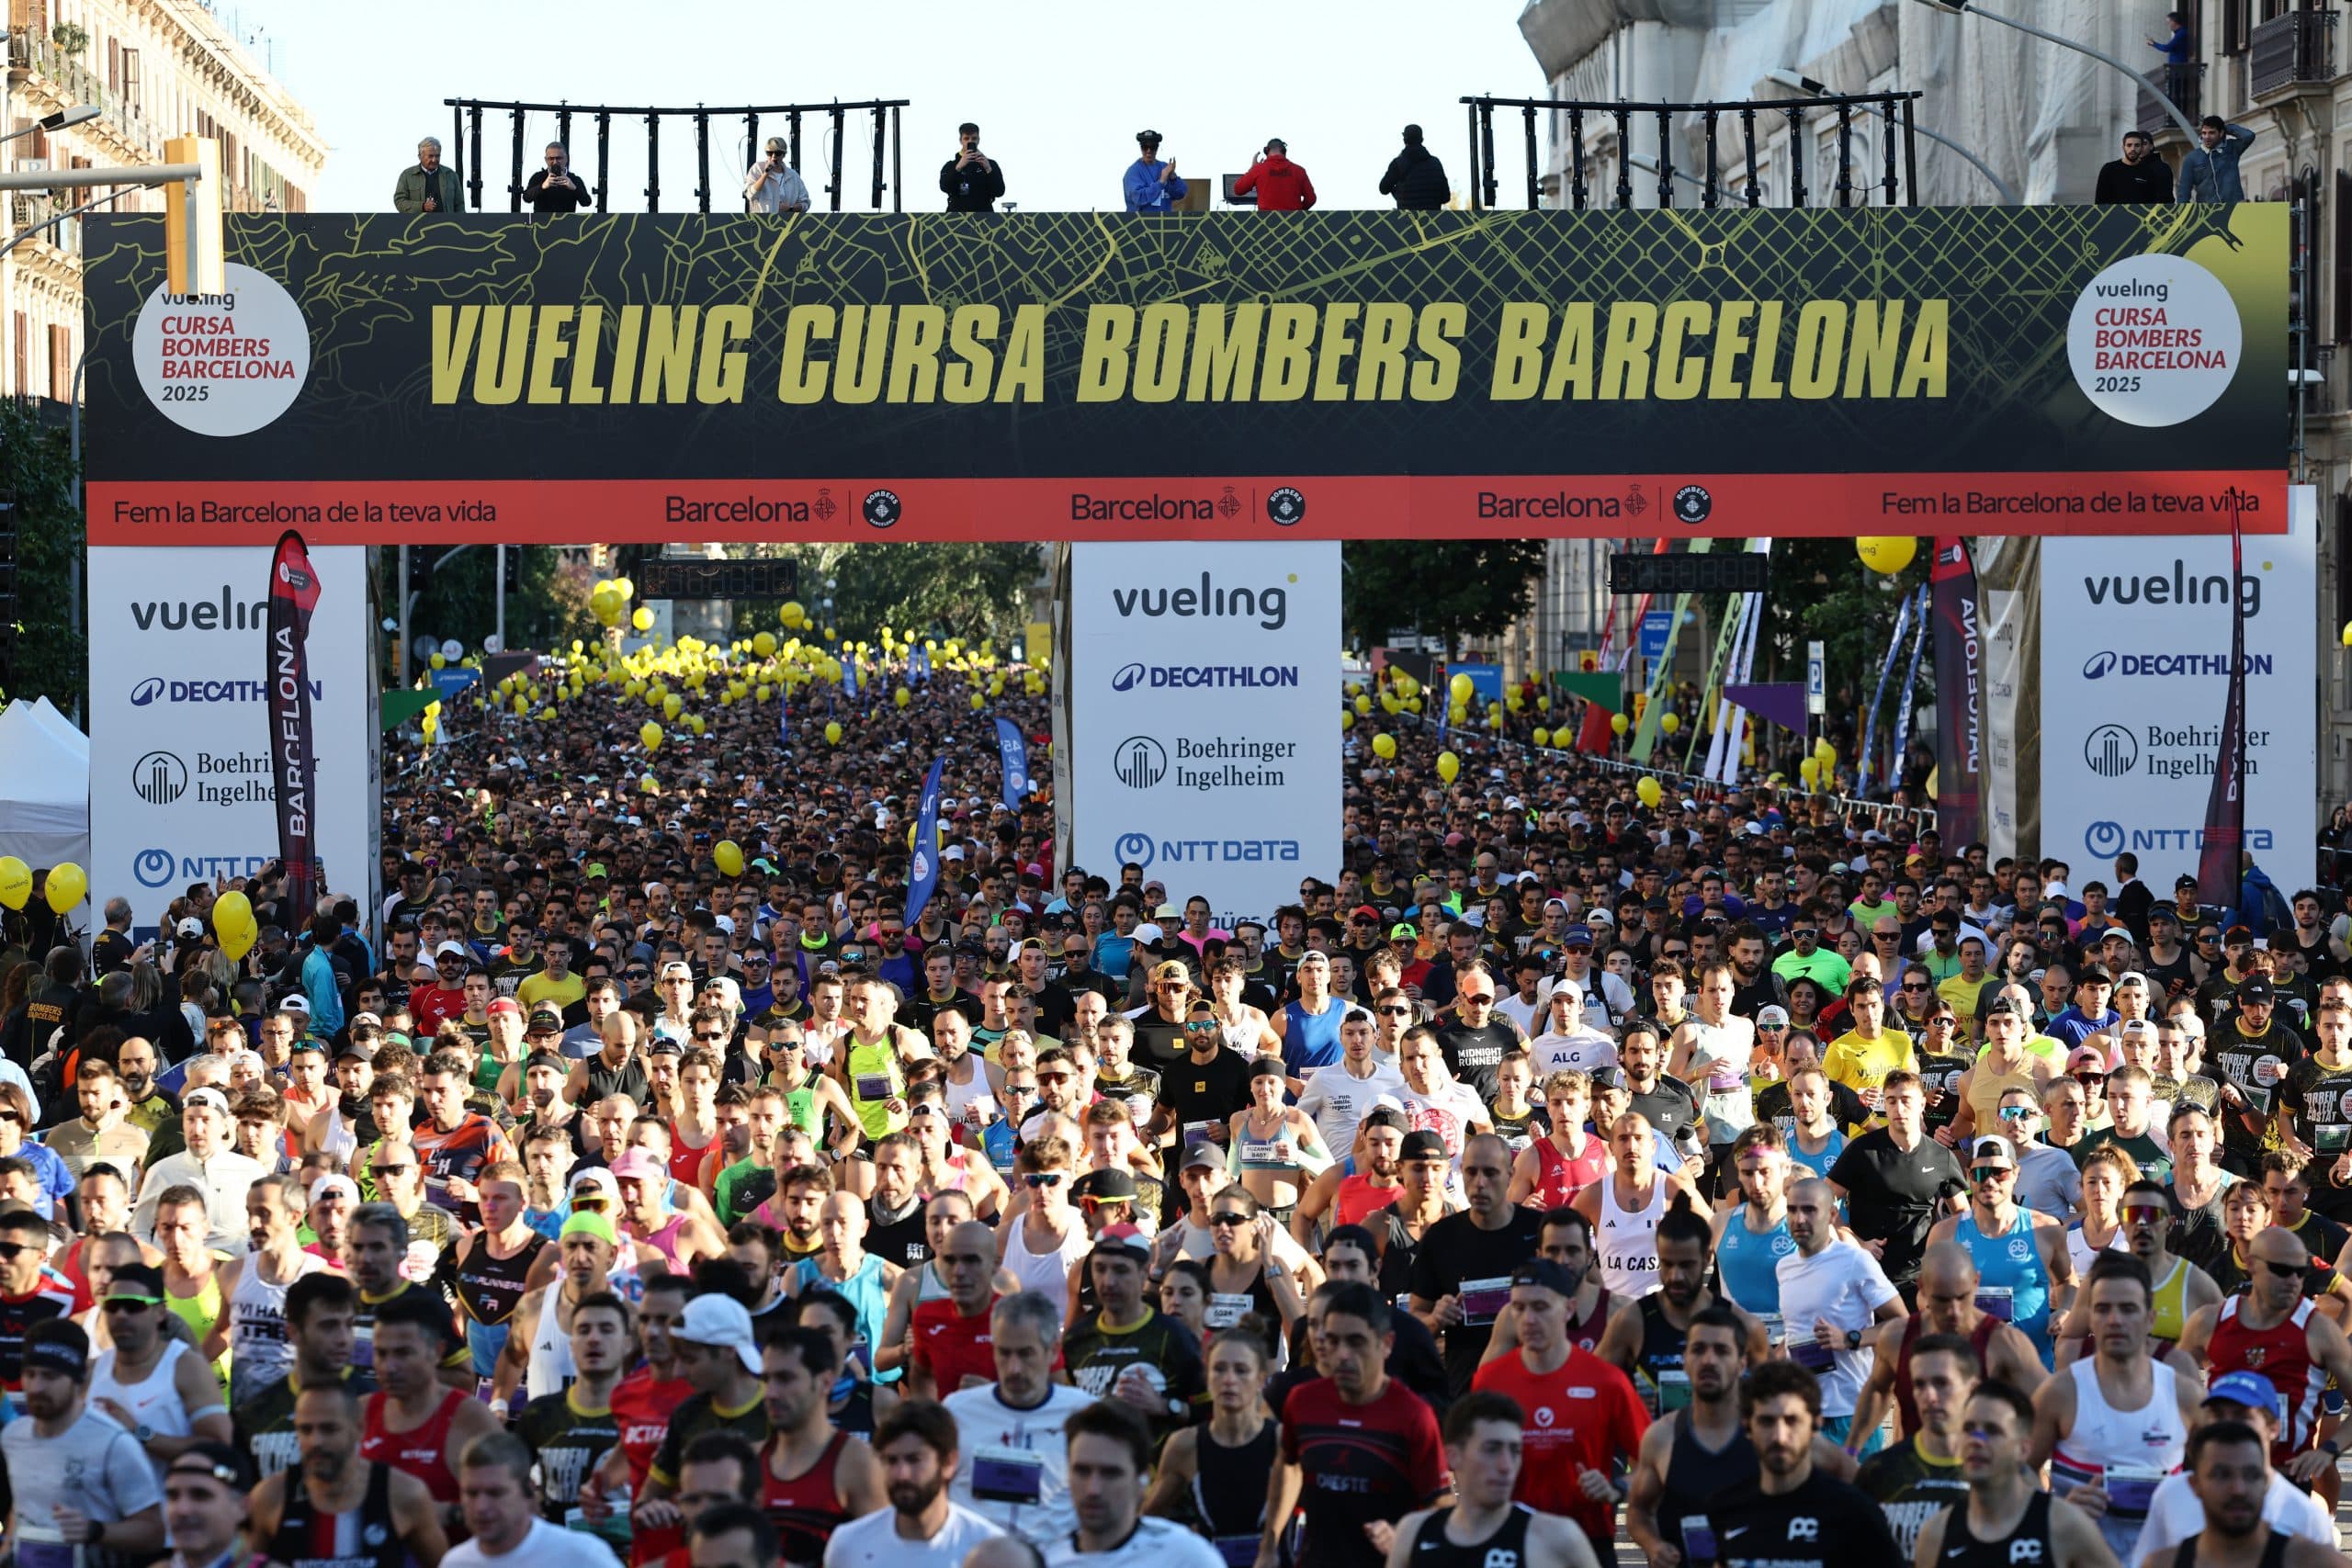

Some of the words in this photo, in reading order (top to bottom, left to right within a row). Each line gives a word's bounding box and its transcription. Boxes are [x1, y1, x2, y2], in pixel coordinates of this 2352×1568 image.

[2096, 279, 2168, 303] vueling
[161, 316, 236, 335] CURSA
[2094, 308, 2167, 326] CURSA
[161, 338, 270, 357] BOMBERS
[2094, 329, 2202, 348] BOMBERS
[431, 303, 752, 405] VUELING
[777, 303, 1046, 404] CURSA
[1075, 301, 1468, 402] BOMBERS
[1489, 299, 1949, 400] BARCELONA
[2094, 350, 2226, 370] BARCELONA
[162, 360, 296, 379] BARCELONA
[162, 385, 209, 401] 2025
[2095, 376, 2142, 393] 2025
[865, 491, 899, 505] BOMBERS
[1270, 488, 1303, 502] BOMBERS
[1676, 486, 1710, 501] BOMBERS
[1882, 491, 1936, 514] Fem
[1941, 491, 1961, 513] la
[1966, 491, 2085, 514] Barcelona
[2090, 491, 2121, 513] de
[2127, 491, 2146, 513] la
[2152, 493, 2204, 513] teva
[2210, 490, 2260, 513] vida
[115, 501, 171, 523] Fem
[175, 500, 195, 523] la
[201, 500, 322, 524] Barcelona
[327, 500, 361, 523] de
[364, 500, 384, 523] la
[390, 502, 442, 523] teva
[447, 500, 497, 522] vida
[666, 495, 809, 523] Barcelona
[1071, 493, 1214, 521] Barcelona
[1477, 491, 1621, 519] Barcelona
[2084, 558, 2261, 618] vueling
[130, 584, 270, 631] vuelin
[1113, 570, 1287, 631] vueling
[1150, 665, 1298, 687] DECATHLON
[170, 680, 322, 702] DECATHN
[2147, 725, 2270, 749] Boehrier
[1176, 736, 1296, 762] Boehringer
[197, 751, 322, 776] Boehrir
[2147, 754, 2258, 780] Ingelhm
[1176, 765, 1285, 791] Ingelheim
[197, 781, 278, 807] Ingelhe
[2133, 829, 2191, 851] NTT
[1162, 840, 1219, 862] NTT
[28, 1001, 62, 1017] BOMBERS
[1458, 1046, 1502, 1058] MIDNIGHT
[1458, 1055, 1503, 1067] RUNNERS
[1551, 1052, 1581, 1064] ALG
[2217, 1052, 2252, 1066] CORREM
[2303, 1090, 2338, 1103] CORREM
[2319, 1101, 2334, 1112] TEU
[2307, 1111, 2337, 1123] COSTAT
[1608, 1256, 1622, 1269] LA
